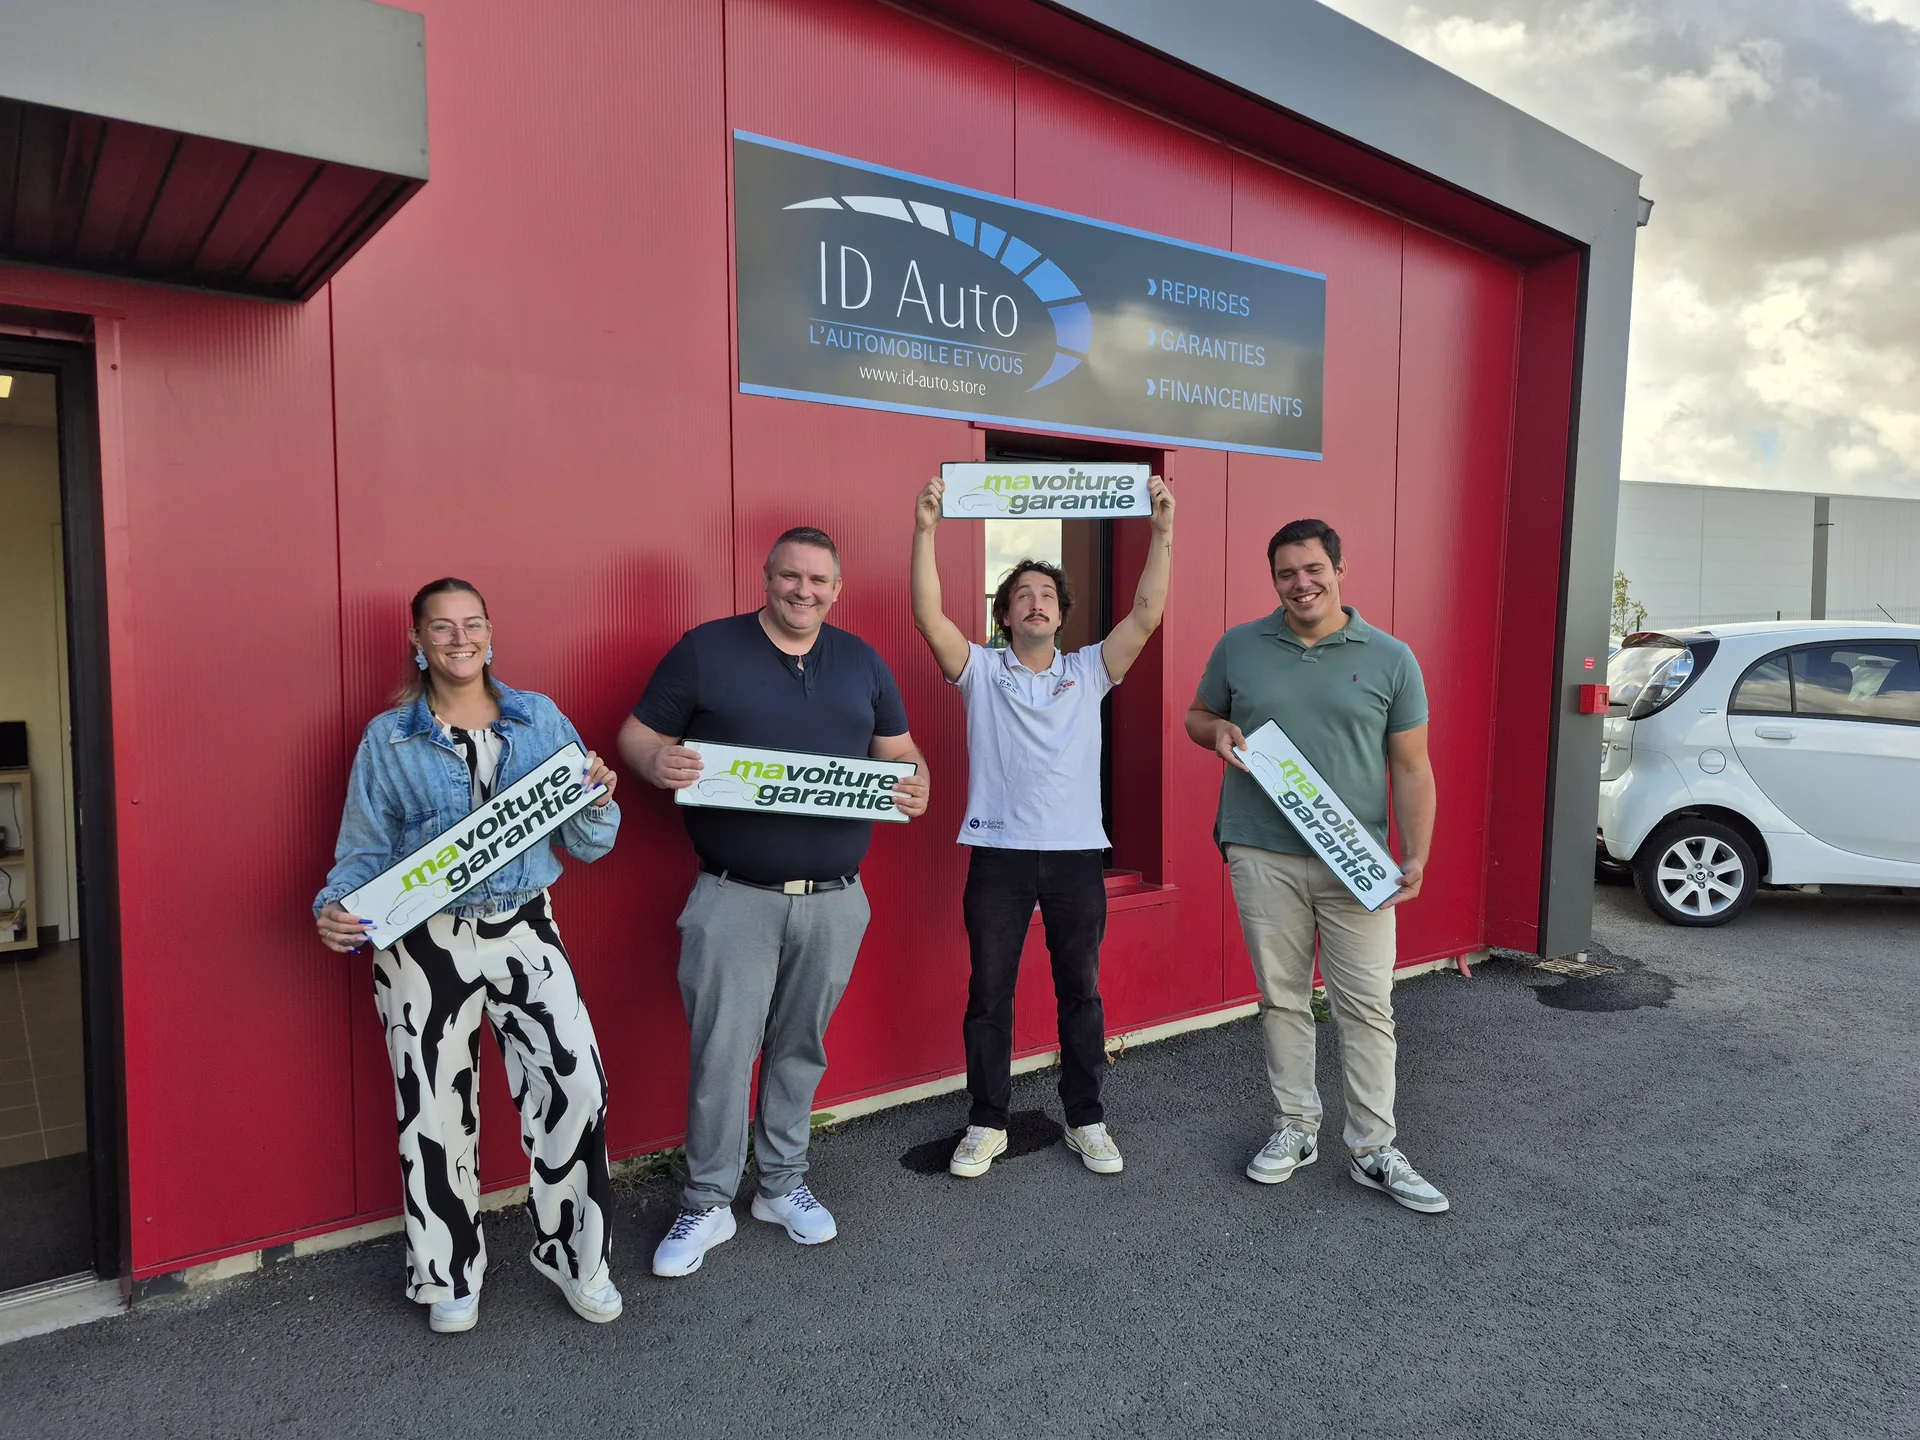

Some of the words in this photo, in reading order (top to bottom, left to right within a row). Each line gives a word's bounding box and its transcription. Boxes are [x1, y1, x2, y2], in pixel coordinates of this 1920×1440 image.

[820, 241, 873, 310] ID
[896, 259, 1018, 338] Auto
[1161, 279, 1250, 317] REPRISES
[809, 324, 949, 365] L'AUTOMOBILE
[953, 349, 973, 368] ET
[977, 352, 1024, 376] VOUS
[1160, 329, 1266, 367] GARANTIES
[859, 366, 987, 396] www.id-auto.store
[1159, 378, 1303, 418] FINANCEMENTS
[983, 467, 1135, 491] mavoiture
[1008, 491, 1135, 515] garantie
[730, 759, 899, 791] mavoiture
[755, 784, 894, 811] garantie
[401, 765, 571, 892] mavoiture
[445, 783, 583, 893] garantie
[1279, 759, 1387, 881] mavoiture
[1278, 791, 1373, 892] garantie
